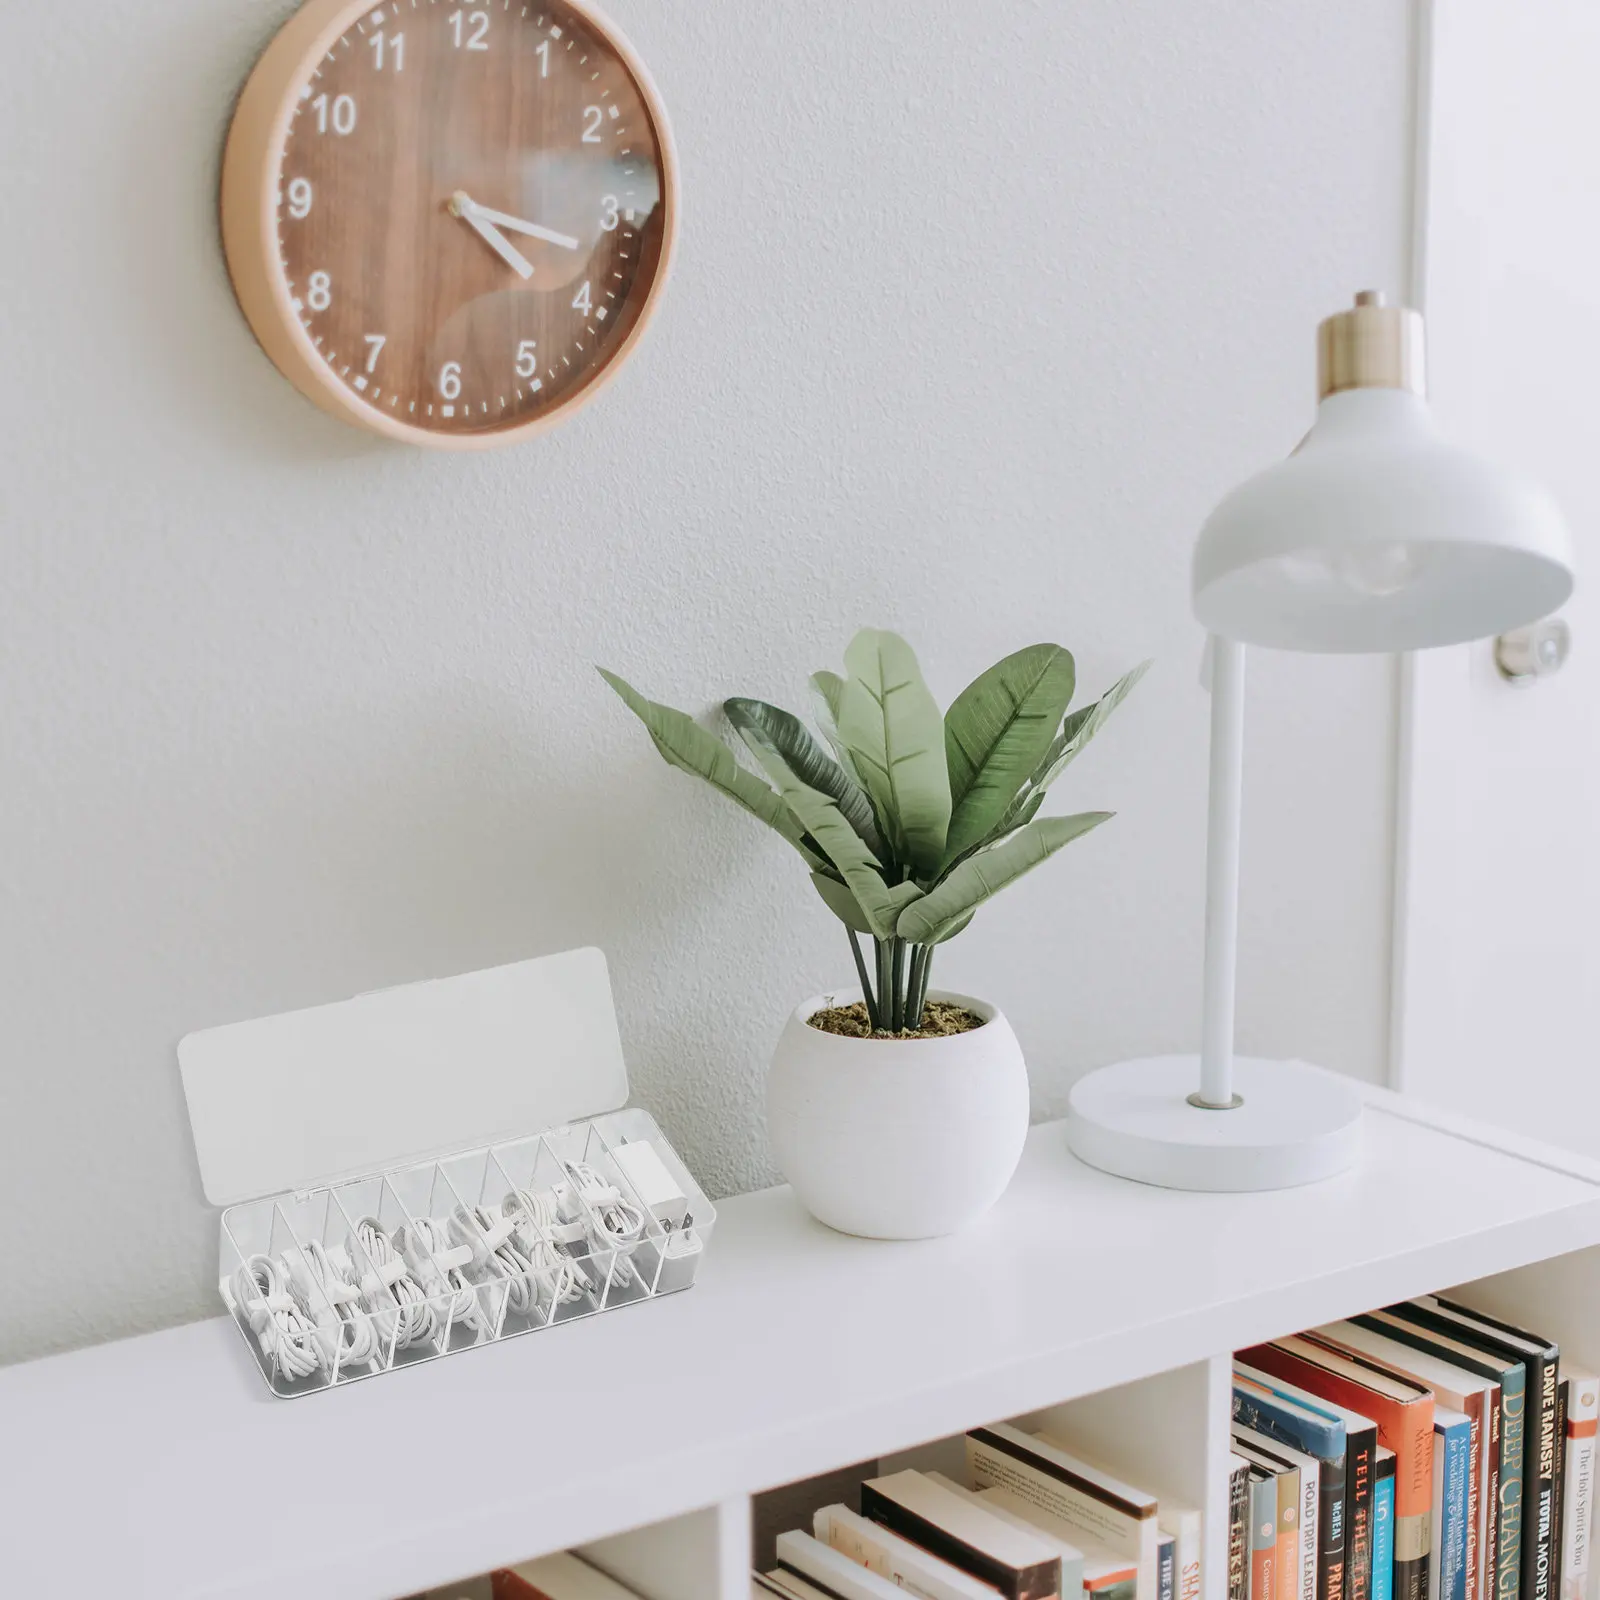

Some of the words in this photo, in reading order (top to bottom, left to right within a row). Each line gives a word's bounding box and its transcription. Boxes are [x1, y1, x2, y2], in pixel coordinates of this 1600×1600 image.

[449, 11, 489, 50] 12
[369, 31, 404, 71] 11
[536, 42, 549, 77] 1
[312, 94, 356, 134] 10
[582, 106, 603, 142] 2
[288, 178, 312, 219] 9
[600, 197, 619, 231] 3
[307, 271, 331, 311] 8
[572, 281, 592, 316] 4
[364, 335, 386, 372] 7
[515, 341, 537, 377] 5
[440, 362, 461, 399] 6
[1543, 1363, 1556, 1408] DAVE
[1460, 1437, 1467, 1445] A
[1471, 1418, 1480, 1441] The
[1492, 1404, 1501, 1443] Schenck
[1503, 1388, 1526, 1469] DEEP
[1414, 1427, 1425, 1491] MAXWELL
[1449, 1439, 1459, 1452] for
[1470, 1443, 1479, 1470] Nuts
[1540, 1409, 1554, 1479] RAMSEY
[1581, 1448, 1592, 1470] The
[1356, 1449, 1369, 1502] TELL
[1448, 1454, 1459, 1503] Weddings
[1457, 1446, 1467, 1518] Contemporary
[1469, 1472, 1477, 1492] and
[1578, 1472, 1590, 1498] Holy
[1305, 1480, 1316, 1518] ROAD
[1448, 1505, 1457, 1515] &
[1469, 1493, 1477, 1522] Bolts
[1490, 1471, 1498, 1528] Understanding
[1576, 1500, 1588, 1532] Spirit
[1305, 1520, 1315, 1551] TRIP
[1355, 1509, 1367, 1552] THE
[1468, 1523, 1476, 1533] of
[1539, 1497, 1551, 1541] TOTAL
[1231, 1520, 1243, 1588] LIKE
[1456, 1520, 1465, 1573] Handbook
[1467, 1535, 1476, 1576] Church
[1489, 1542, 1497, 1562] Book
[1499, 1477, 1523, 1600] CHANGE
[1575, 1544, 1585, 1566] You
[1576, 1534, 1584, 1543] &
